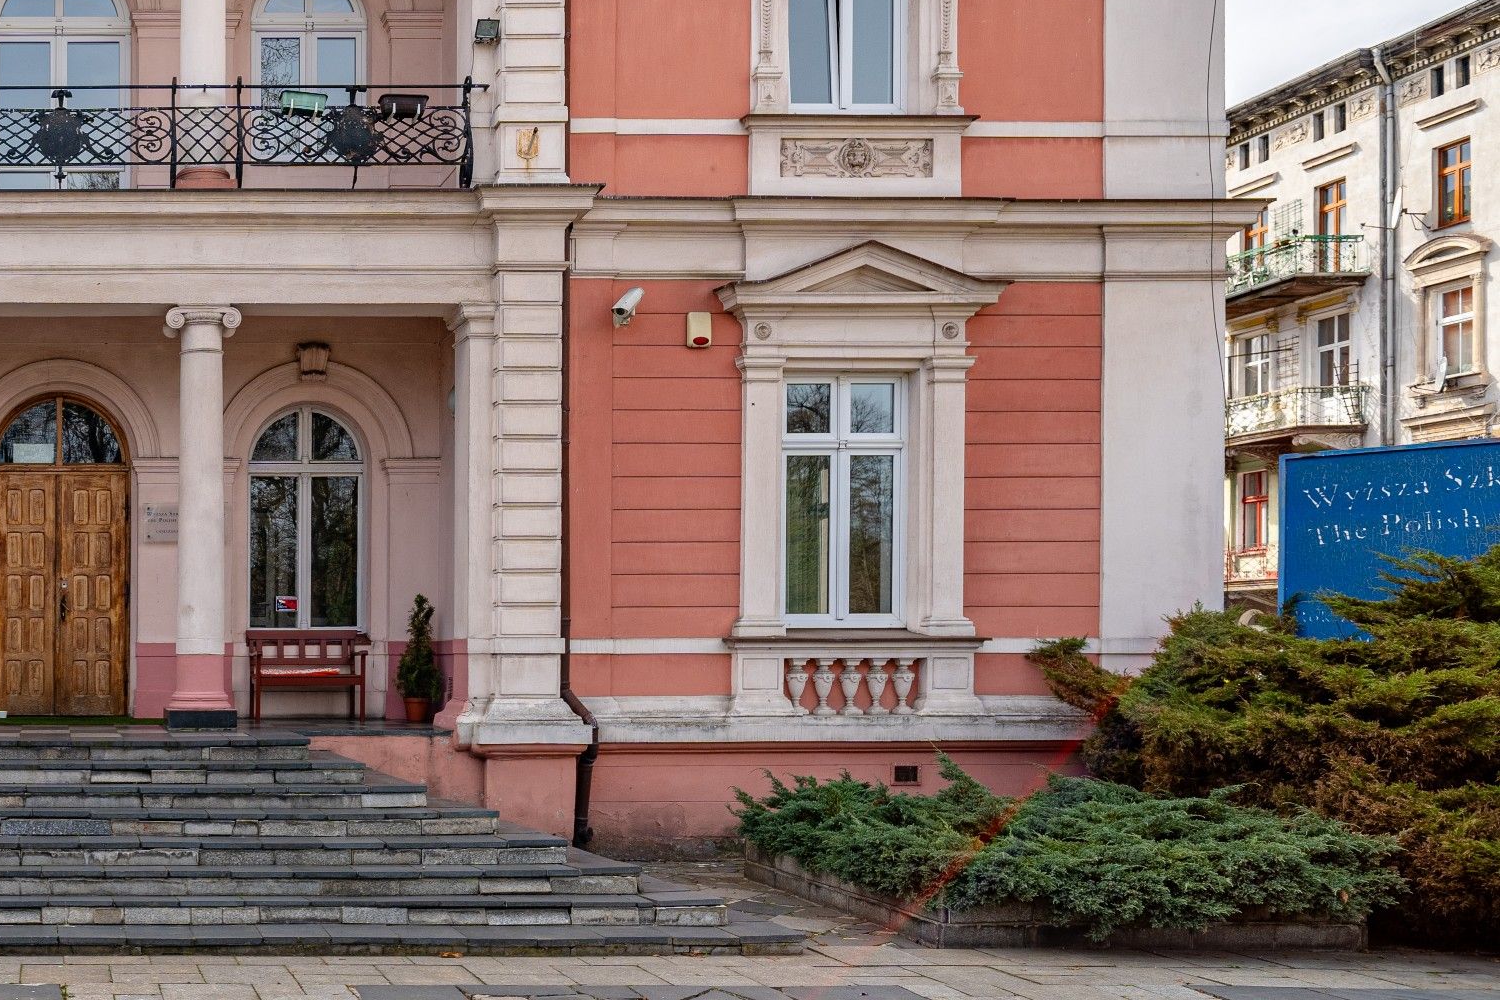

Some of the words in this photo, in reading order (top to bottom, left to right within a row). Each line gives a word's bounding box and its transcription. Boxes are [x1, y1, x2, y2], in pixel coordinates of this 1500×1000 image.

[1303, 481, 1430, 510] Wyższa
[1308, 524, 1367, 545] The
[1381, 508, 1481, 536] Polish
